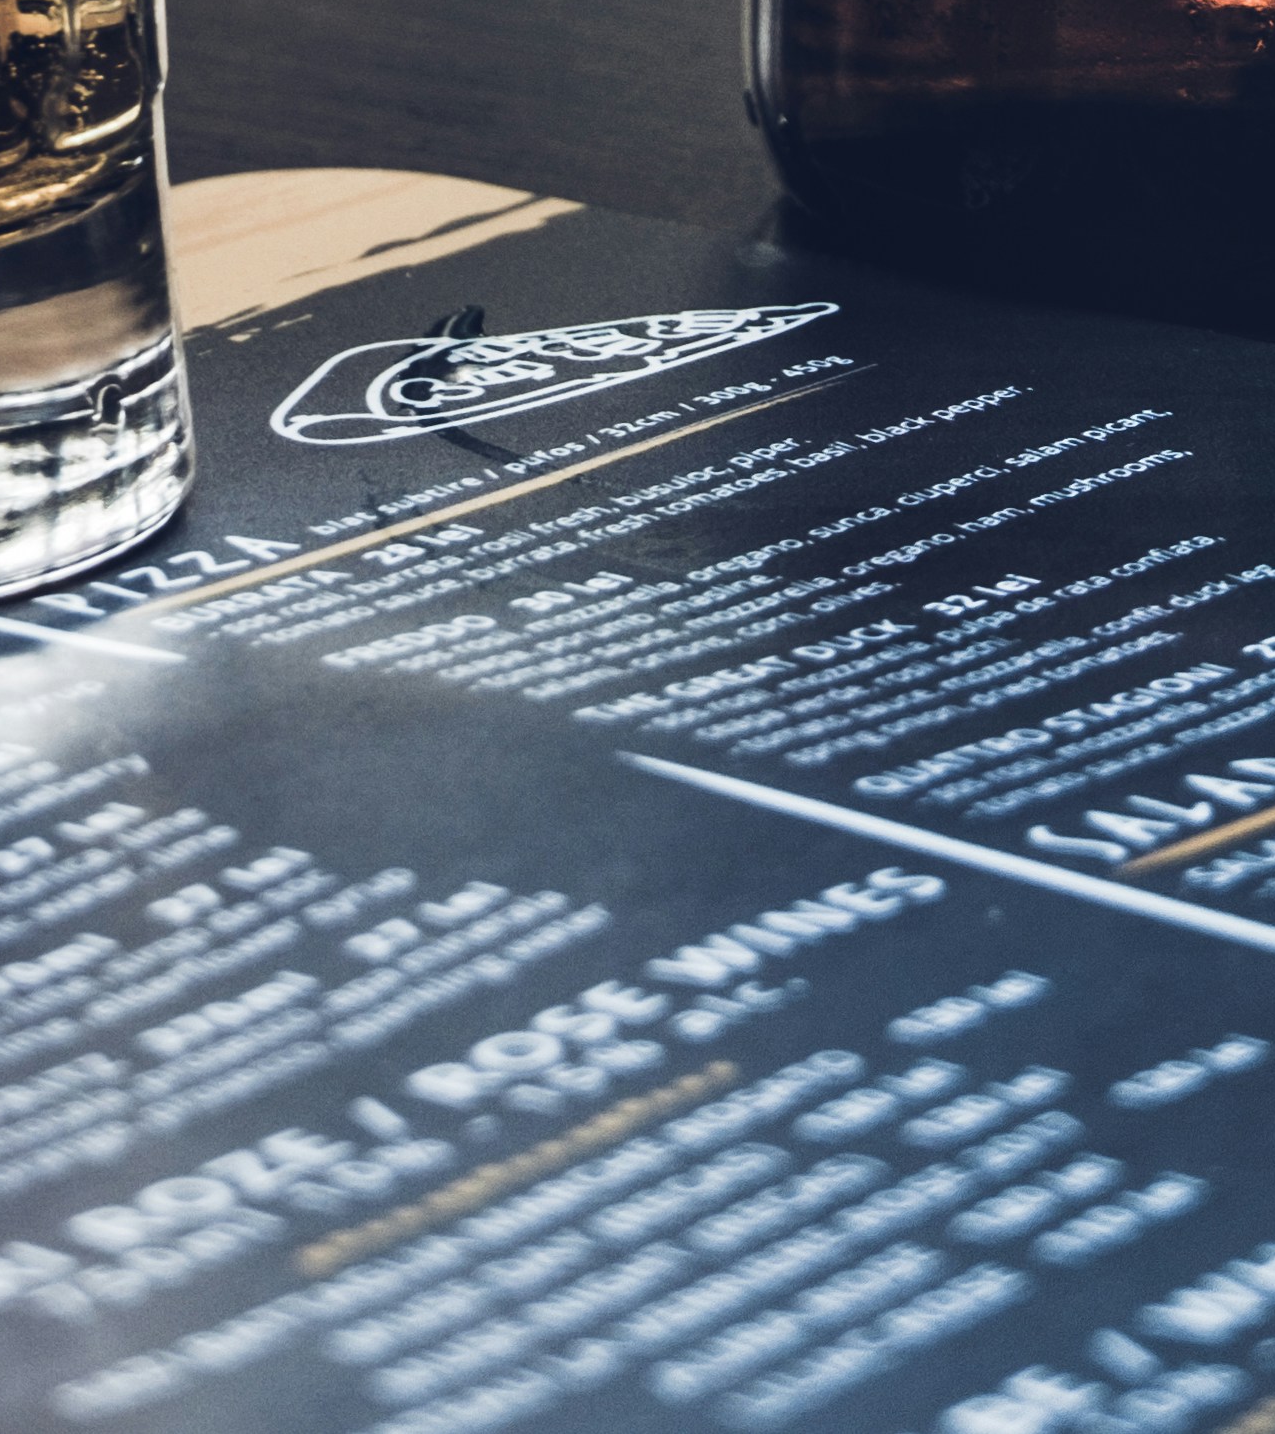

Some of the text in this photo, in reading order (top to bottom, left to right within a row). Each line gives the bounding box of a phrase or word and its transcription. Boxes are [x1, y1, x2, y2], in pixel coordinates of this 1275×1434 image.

[33, 535, 310, 616] PIZZA
[307, 510, 378, 535] blat
[377, 476, 483, 515] subtire
[501, 441, 585, 475] pufos
[597, 409, 681, 438] 32cm
[692, 381, 772, 405] 300g
[781, 354, 854, 377] 450g
[528, 505, 620, 534] fresh,
[609, 465, 734, 506] busuioc,
[727, 436, 811, 469] piper.
[576, 512, 660, 540] fresh
[653, 467, 796, 515] tomatoes,
[783, 440, 867, 468] basil,
[854, 415, 935, 443] black
[930, 385, 1033, 421] pepper.
[807, 506, 901, 539] sunca,
[896, 464, 1011, 506] ciuperci,
[1004, 436, 1085, 467] salam
[1081, 408, 1173, 441] picant,
[955, 506, 1035, 532] ham,
[1029, 448, 1193, 506] mushrooms,
[1109, 534, 1225, 577] confiata,
[791, 618, 915, 660] DUCK
[922, 593, 988, 616] 32
[972, 572, 1041, 596] lei
